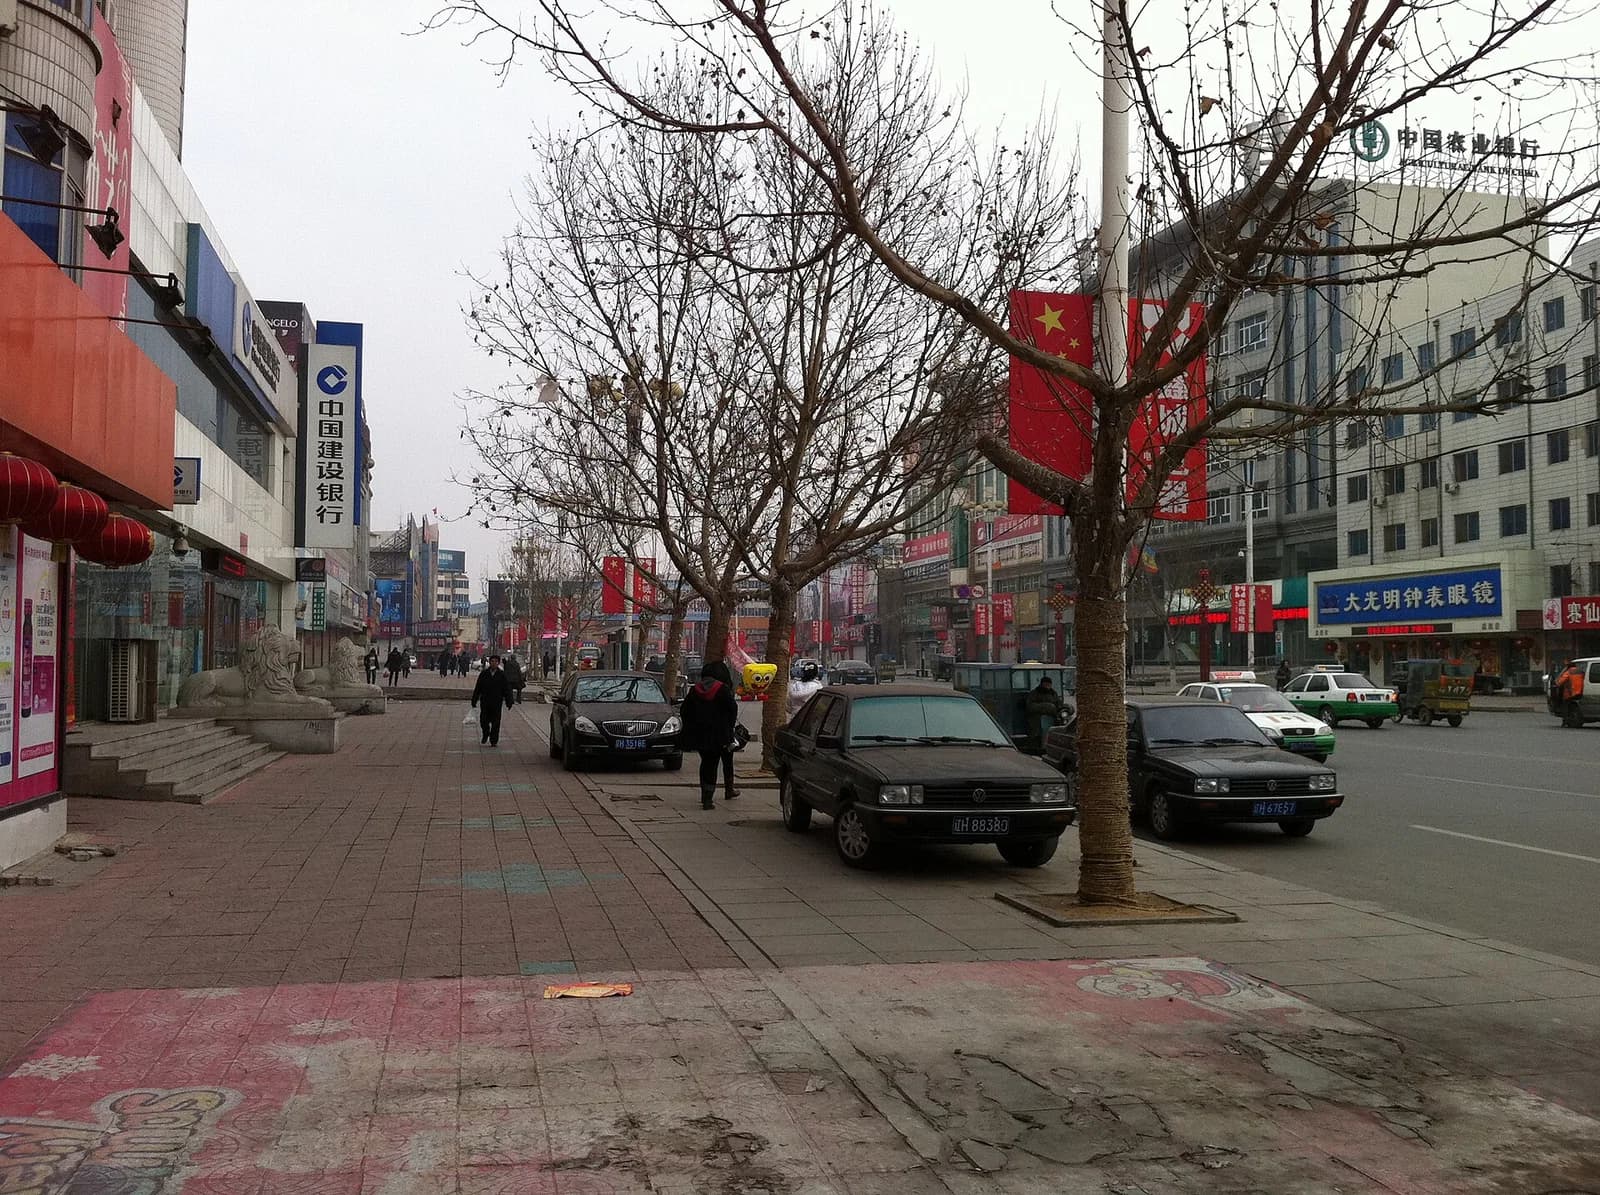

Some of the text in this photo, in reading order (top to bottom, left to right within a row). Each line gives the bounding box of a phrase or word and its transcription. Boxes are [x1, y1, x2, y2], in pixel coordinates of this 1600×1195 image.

[1398, 127, 1540, 160] 中国农业银行
[316, 400, 344, 525] 中国建设银行
[1344, 580, 1496, 613] 大光明钟表眼镜
